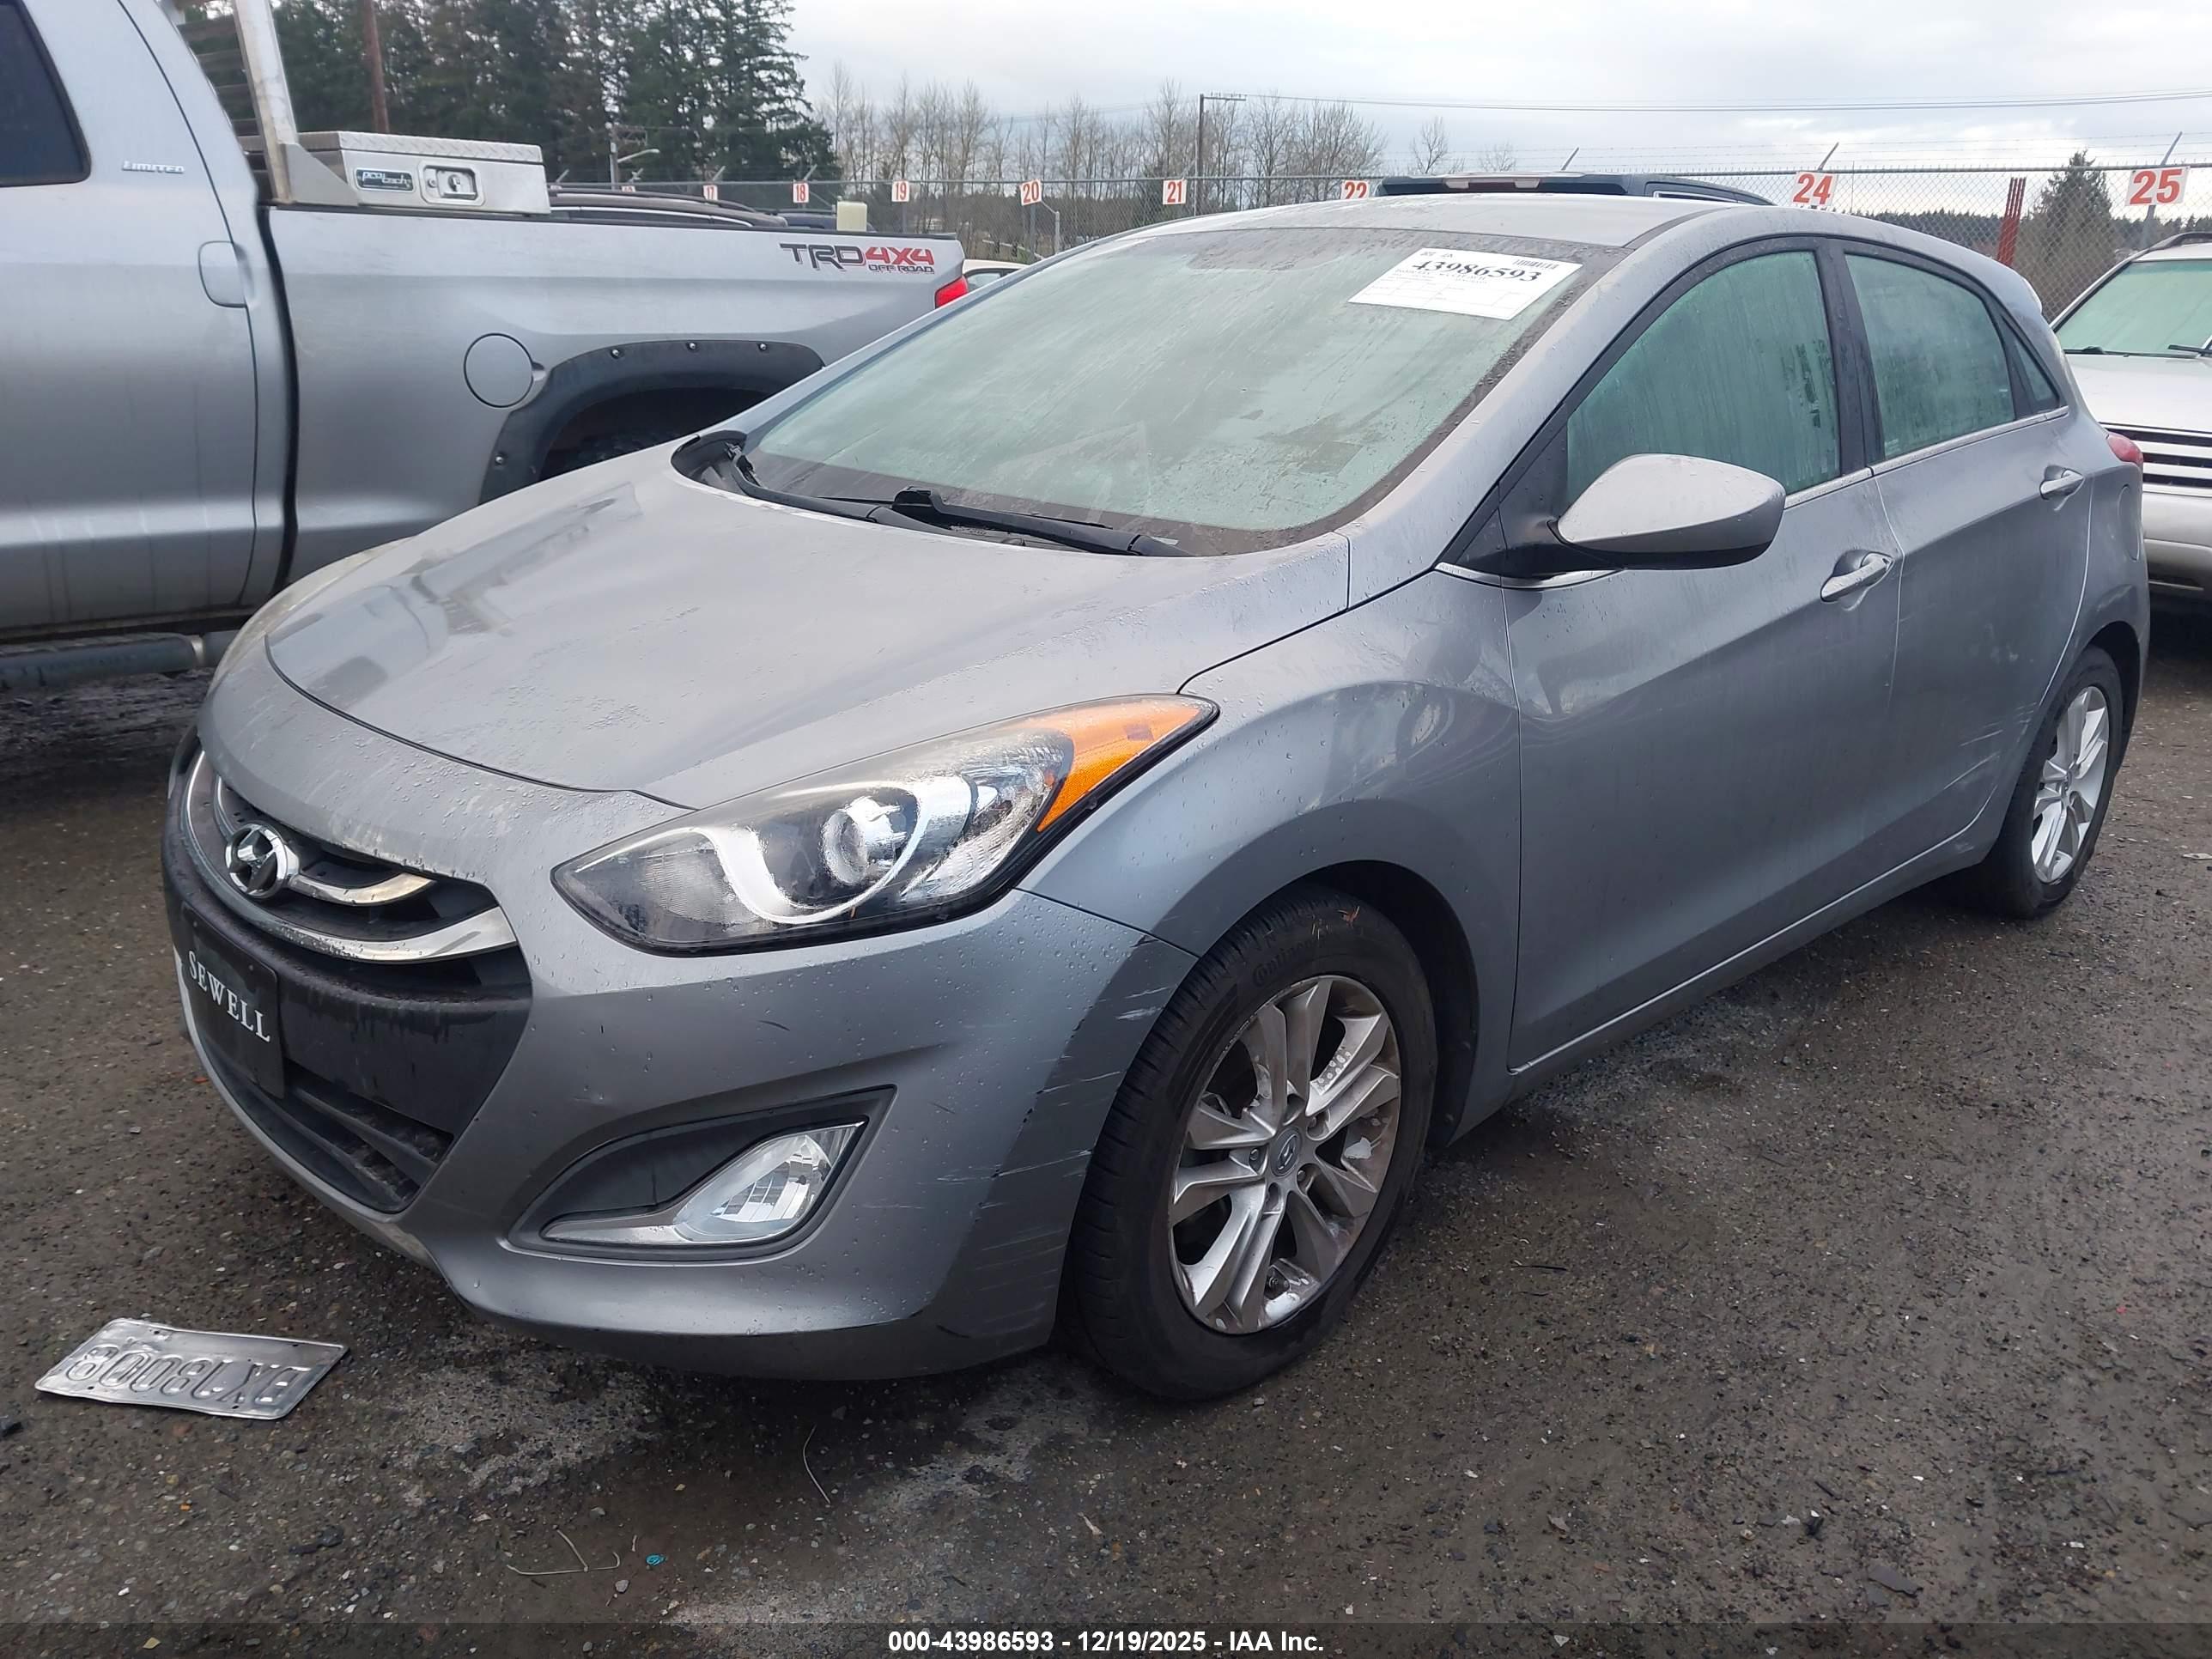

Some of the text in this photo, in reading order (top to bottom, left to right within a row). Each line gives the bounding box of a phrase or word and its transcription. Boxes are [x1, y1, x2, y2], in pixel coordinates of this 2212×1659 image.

[123, 161, 185, 173] LIMITED
[706, 185, 716, 201] 17
[795, 185, 805, 202] 18
[895, 182, 908, 201] 19
[1022, 182, 1040, 204] 20
[1167, 181, 1184, 204] 21
[1792, 172, 1832, 205] 24
[2130, 167, 2184, 205] 25
[1413, 259, 1543, 283] 43986593
[188, 950, 271, 1043] SEWELL
